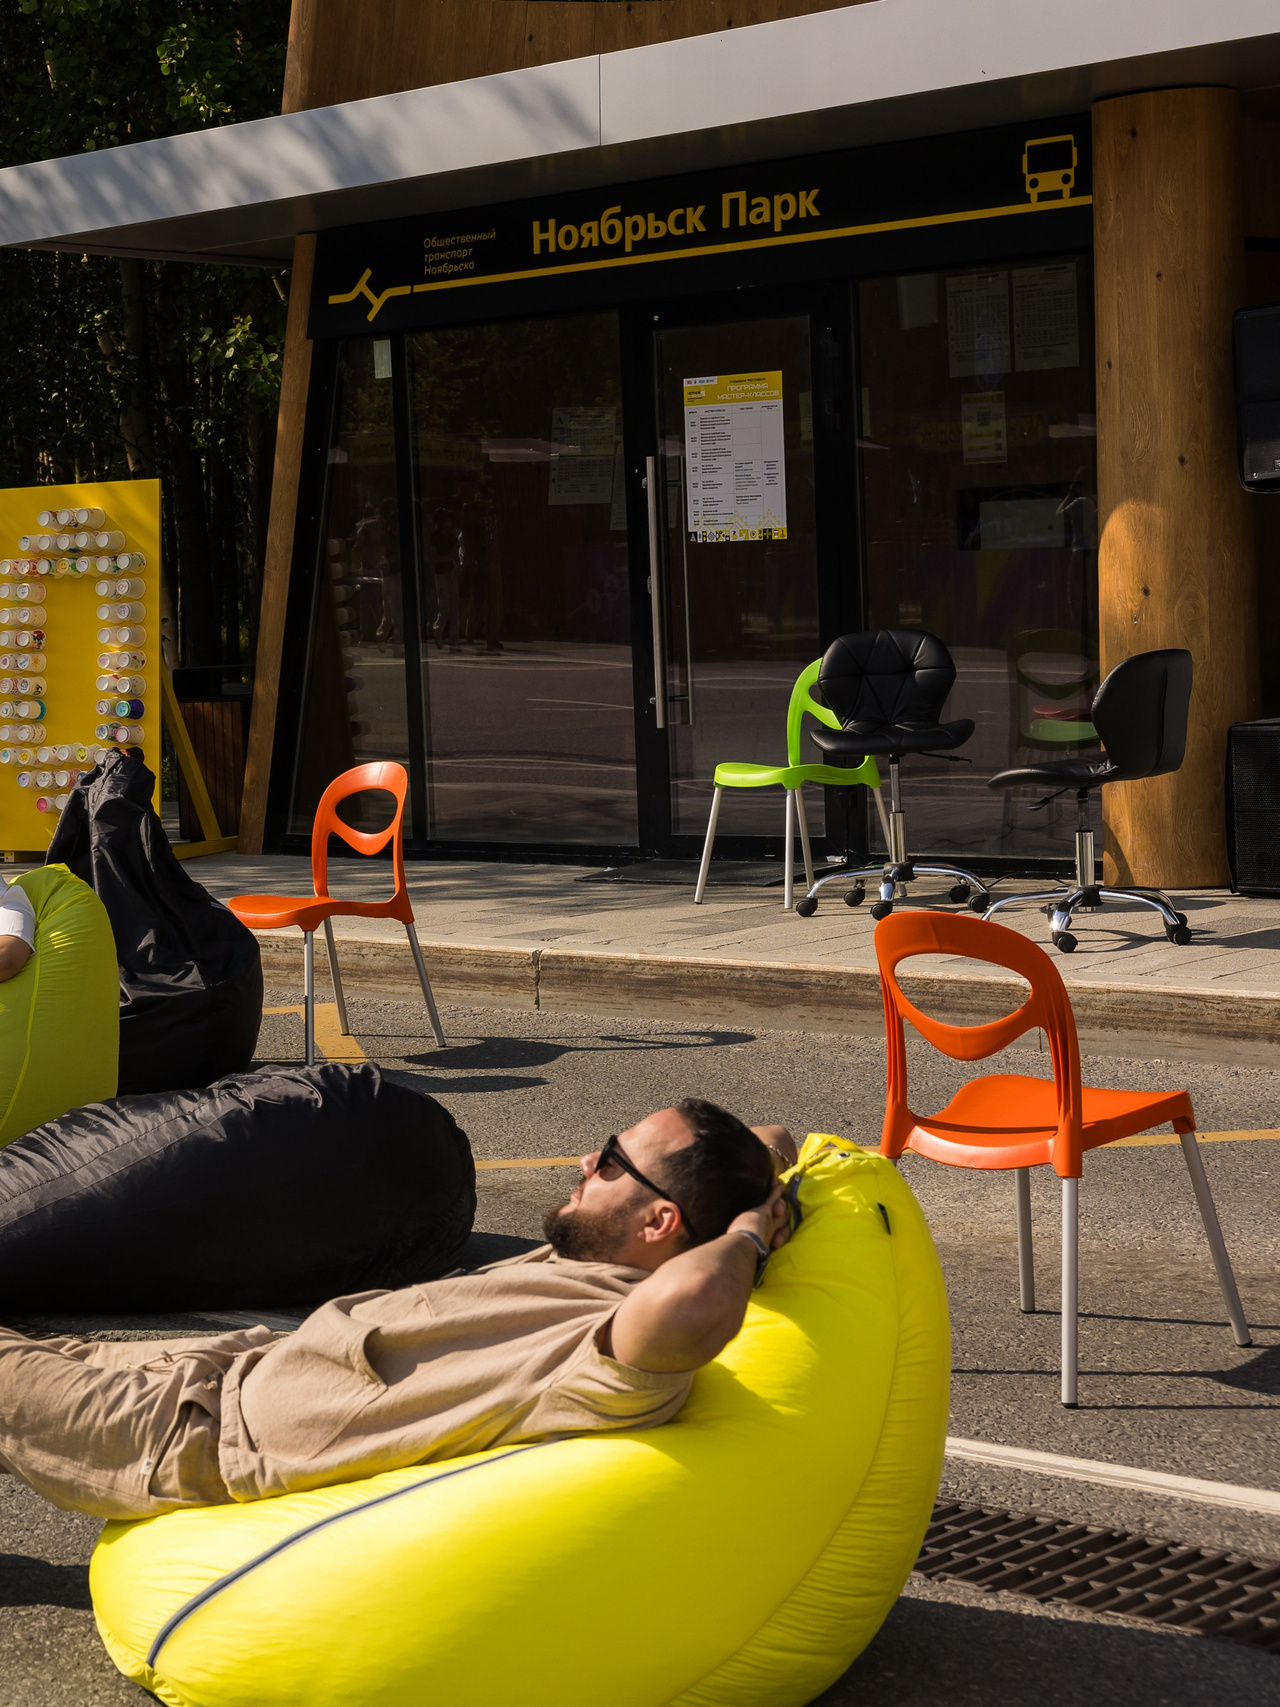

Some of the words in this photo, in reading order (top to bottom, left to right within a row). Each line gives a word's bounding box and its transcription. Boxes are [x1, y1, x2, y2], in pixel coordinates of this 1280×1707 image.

[531, 204, 708, 256] Ноябрьск
[721, 187, 821, 233] Парк
[423, 228, 497, 249] Общественный
[423, 247, 473, 263] транспорт
[423, 261, 476, 276] Ноябрьска
[727, 382, 769, 392] ПРОГРАММА
[717, 390, 780, 401] МАСТЕР-КЛАССОВ
